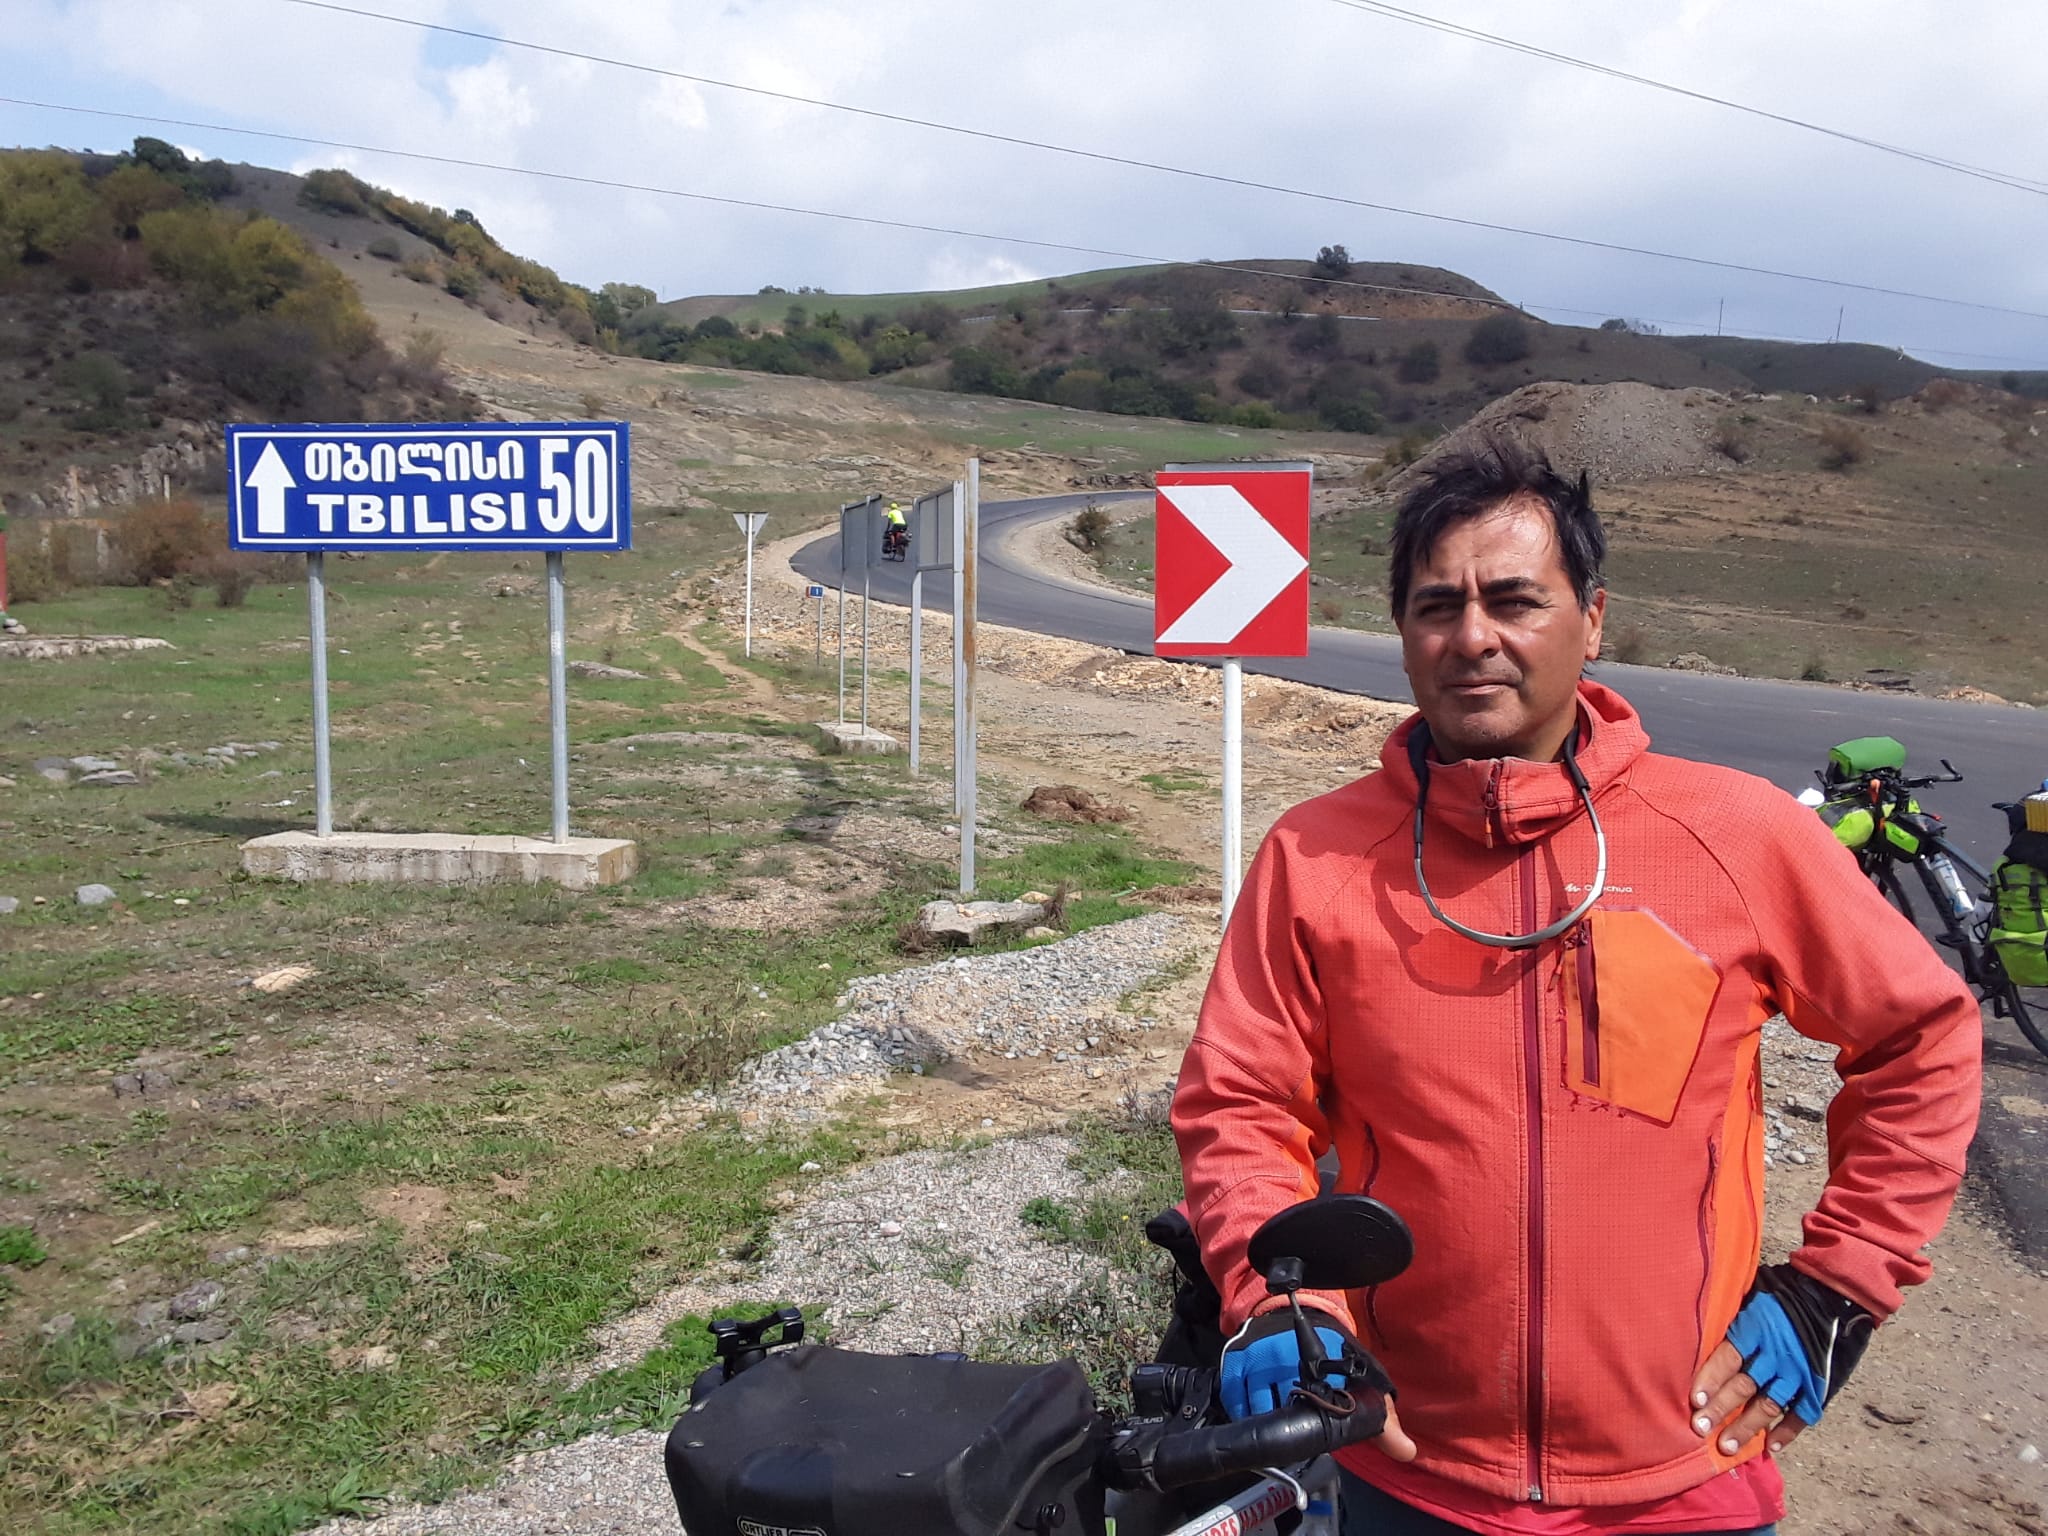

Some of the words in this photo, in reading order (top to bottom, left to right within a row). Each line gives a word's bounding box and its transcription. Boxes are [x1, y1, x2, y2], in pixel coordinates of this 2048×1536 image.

[304, 440, 525, 483] თბილისი
[538, 438, 609, 533] 50
[306, 491, 527, 534] TBILISI
